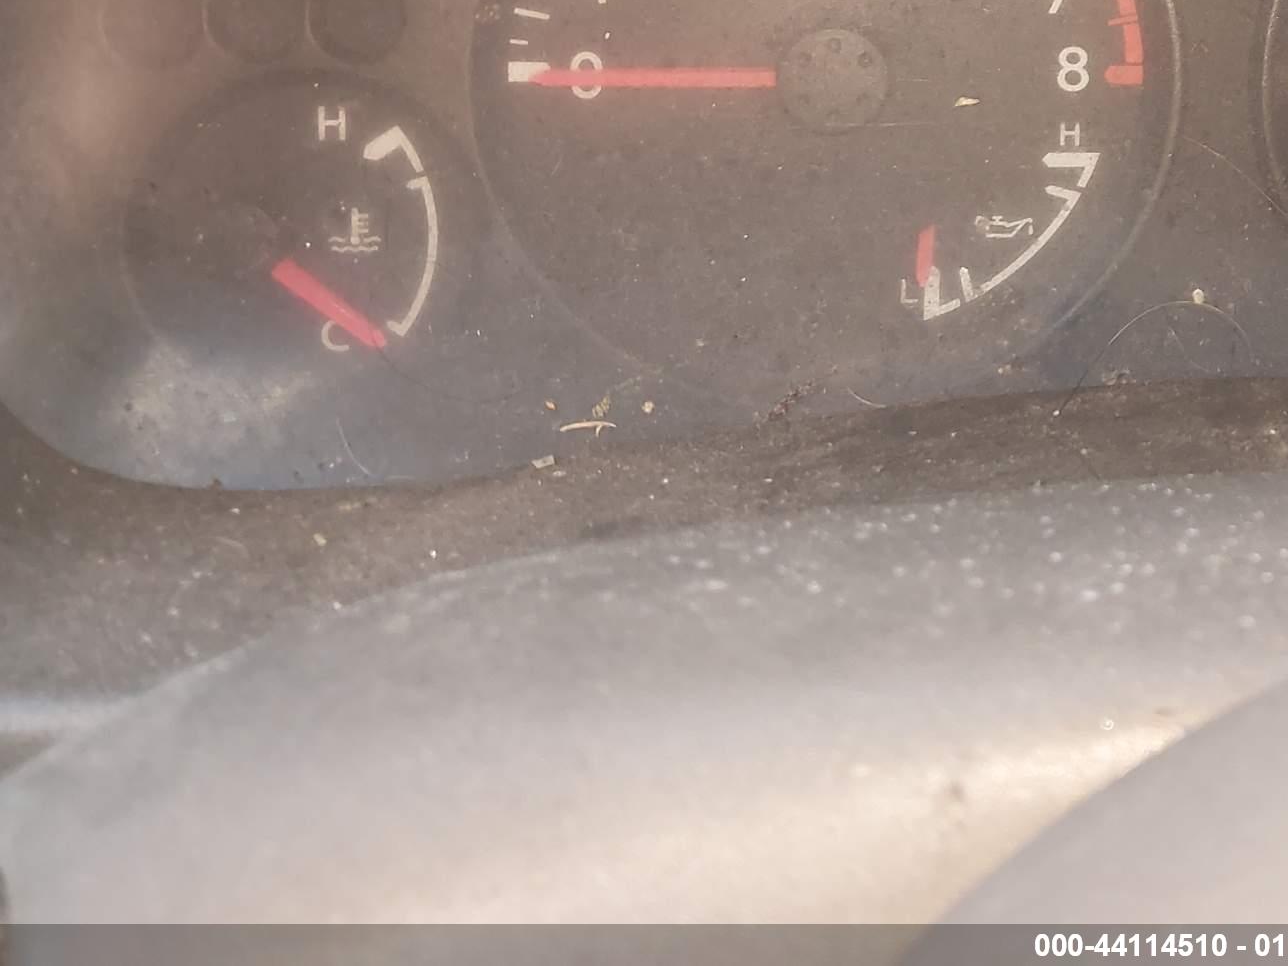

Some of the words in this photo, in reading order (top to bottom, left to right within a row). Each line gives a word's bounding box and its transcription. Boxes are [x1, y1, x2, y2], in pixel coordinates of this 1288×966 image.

[570, 51, 603, 99] 0
[1056, 46, 1090, 92] 8
[318, 106, 346, 141] H
[1059, 123, 1081, 147] H
